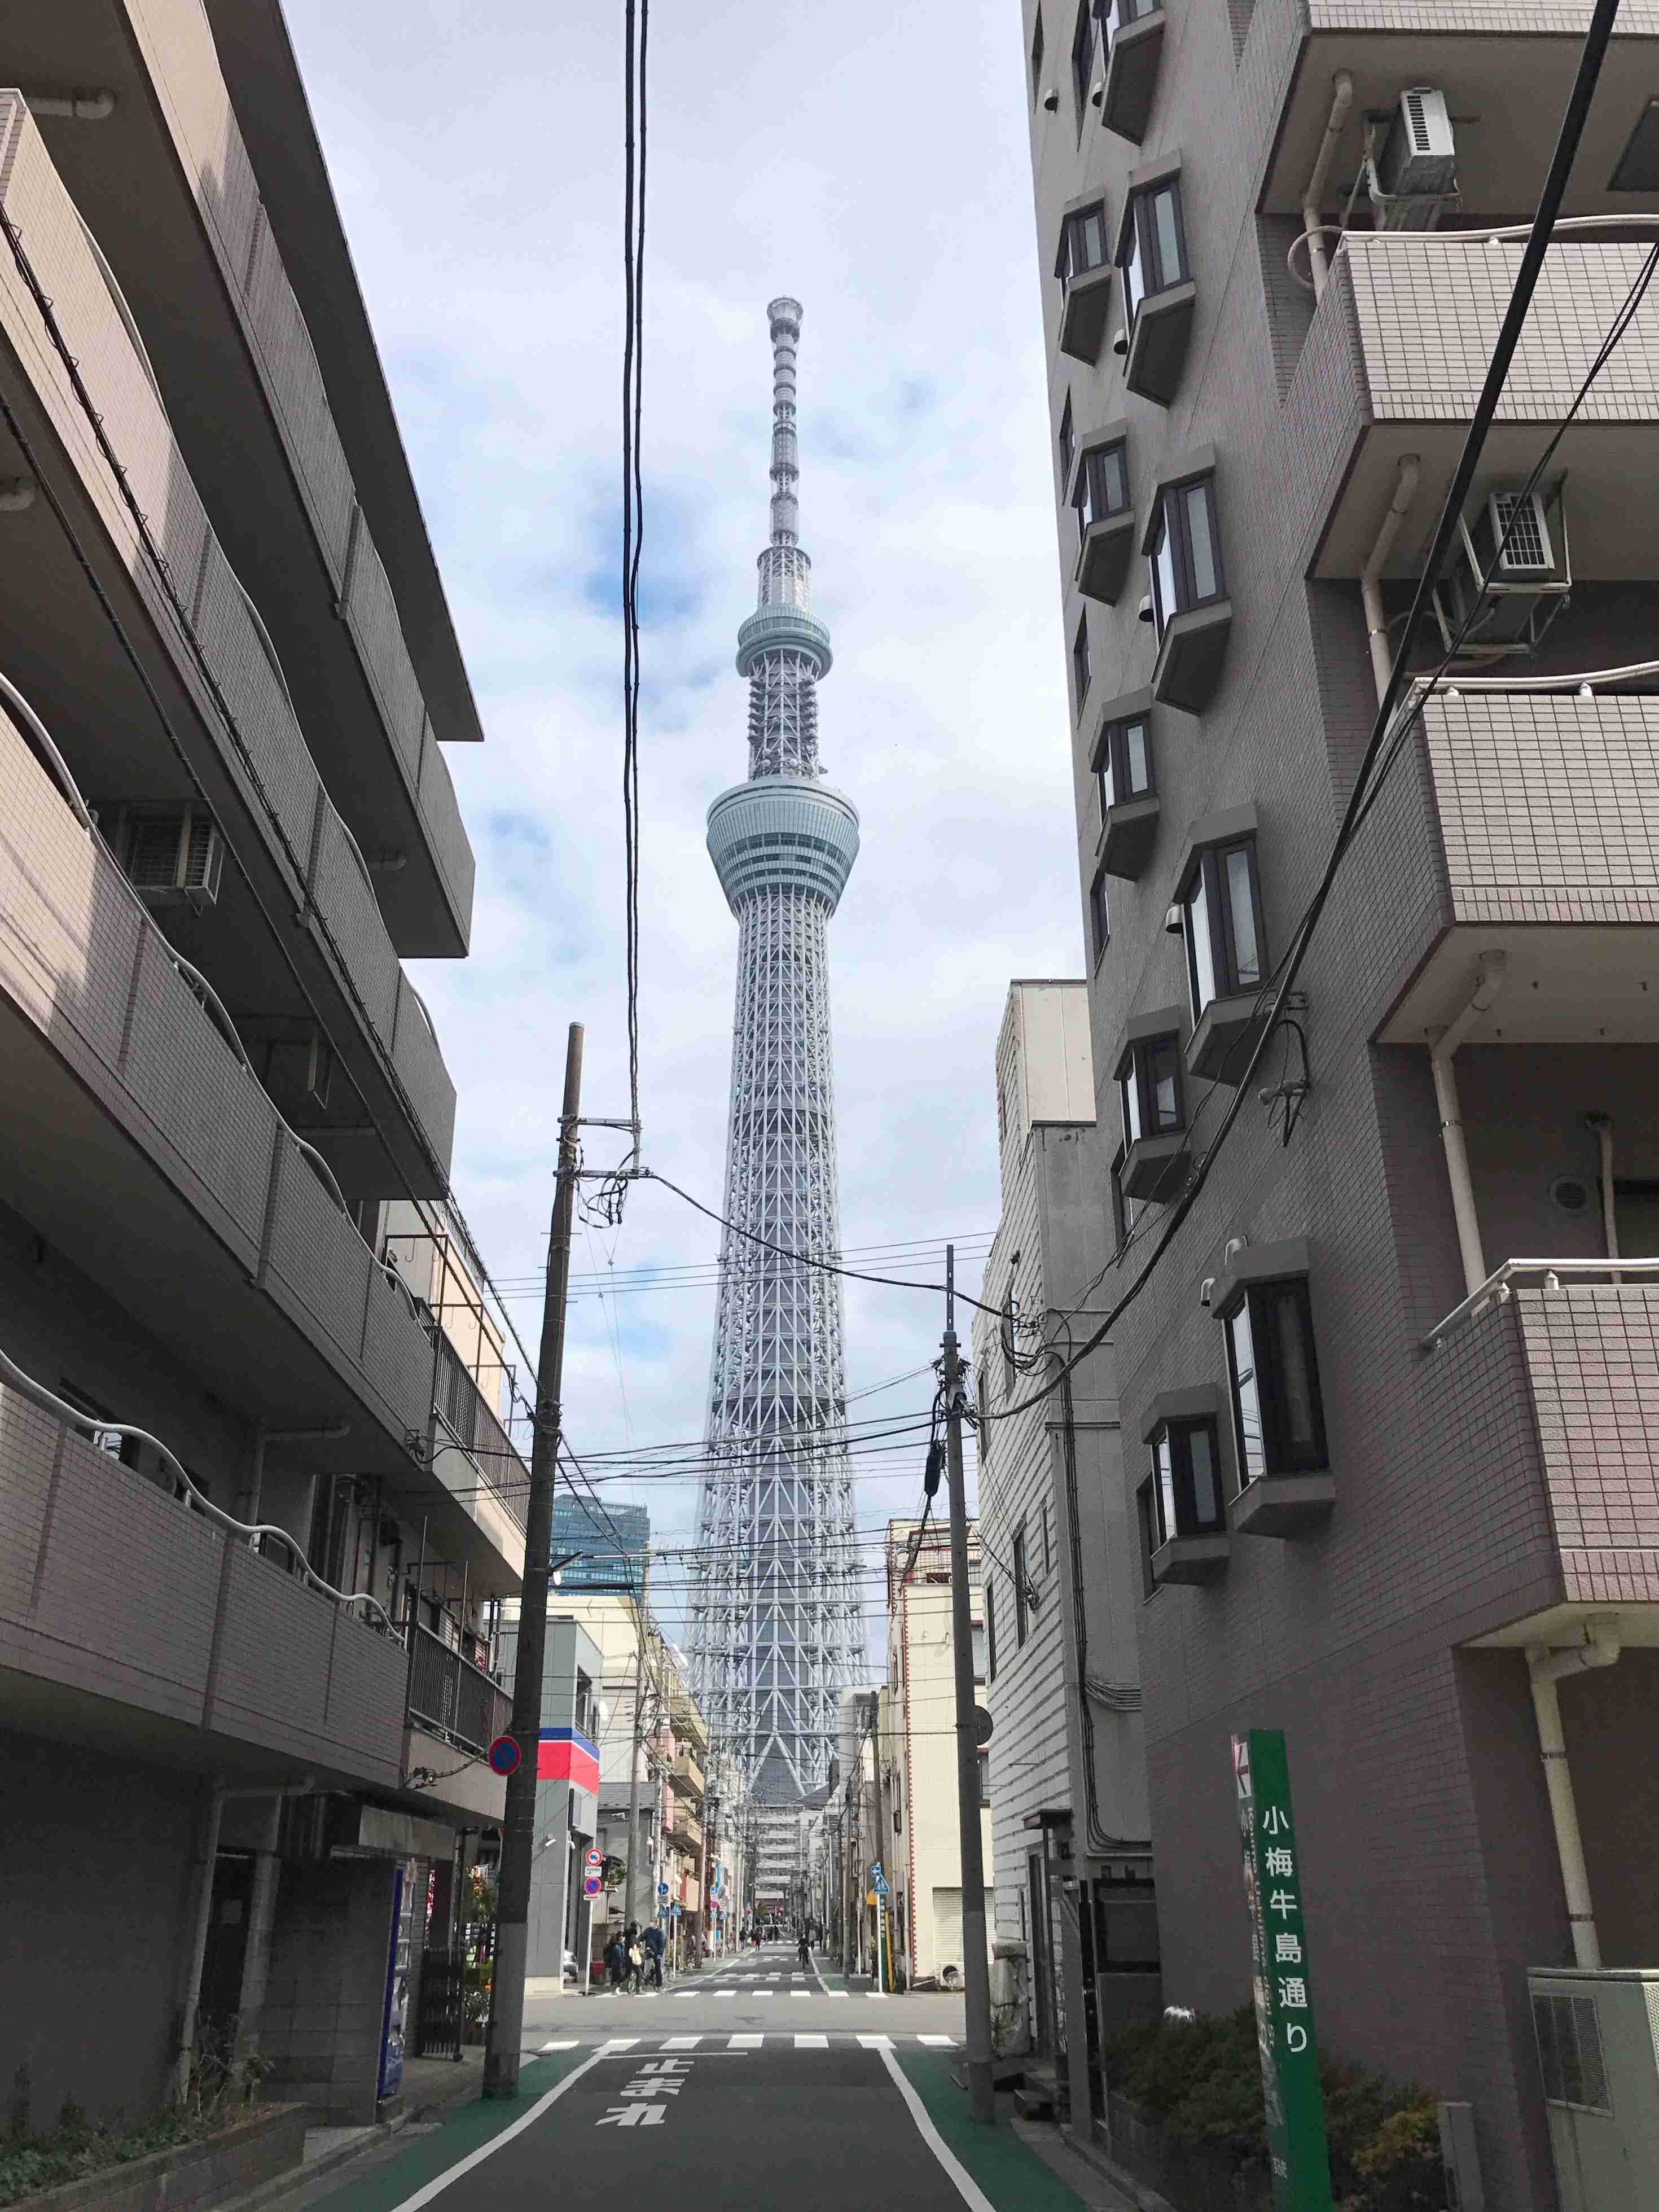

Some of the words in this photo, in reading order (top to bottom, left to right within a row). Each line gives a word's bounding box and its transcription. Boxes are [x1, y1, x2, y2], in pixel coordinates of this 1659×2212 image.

[1263, 1806, 1308, 2053] 小梅牛島通り
[595, 2058, 695, 2126] 止まれ
